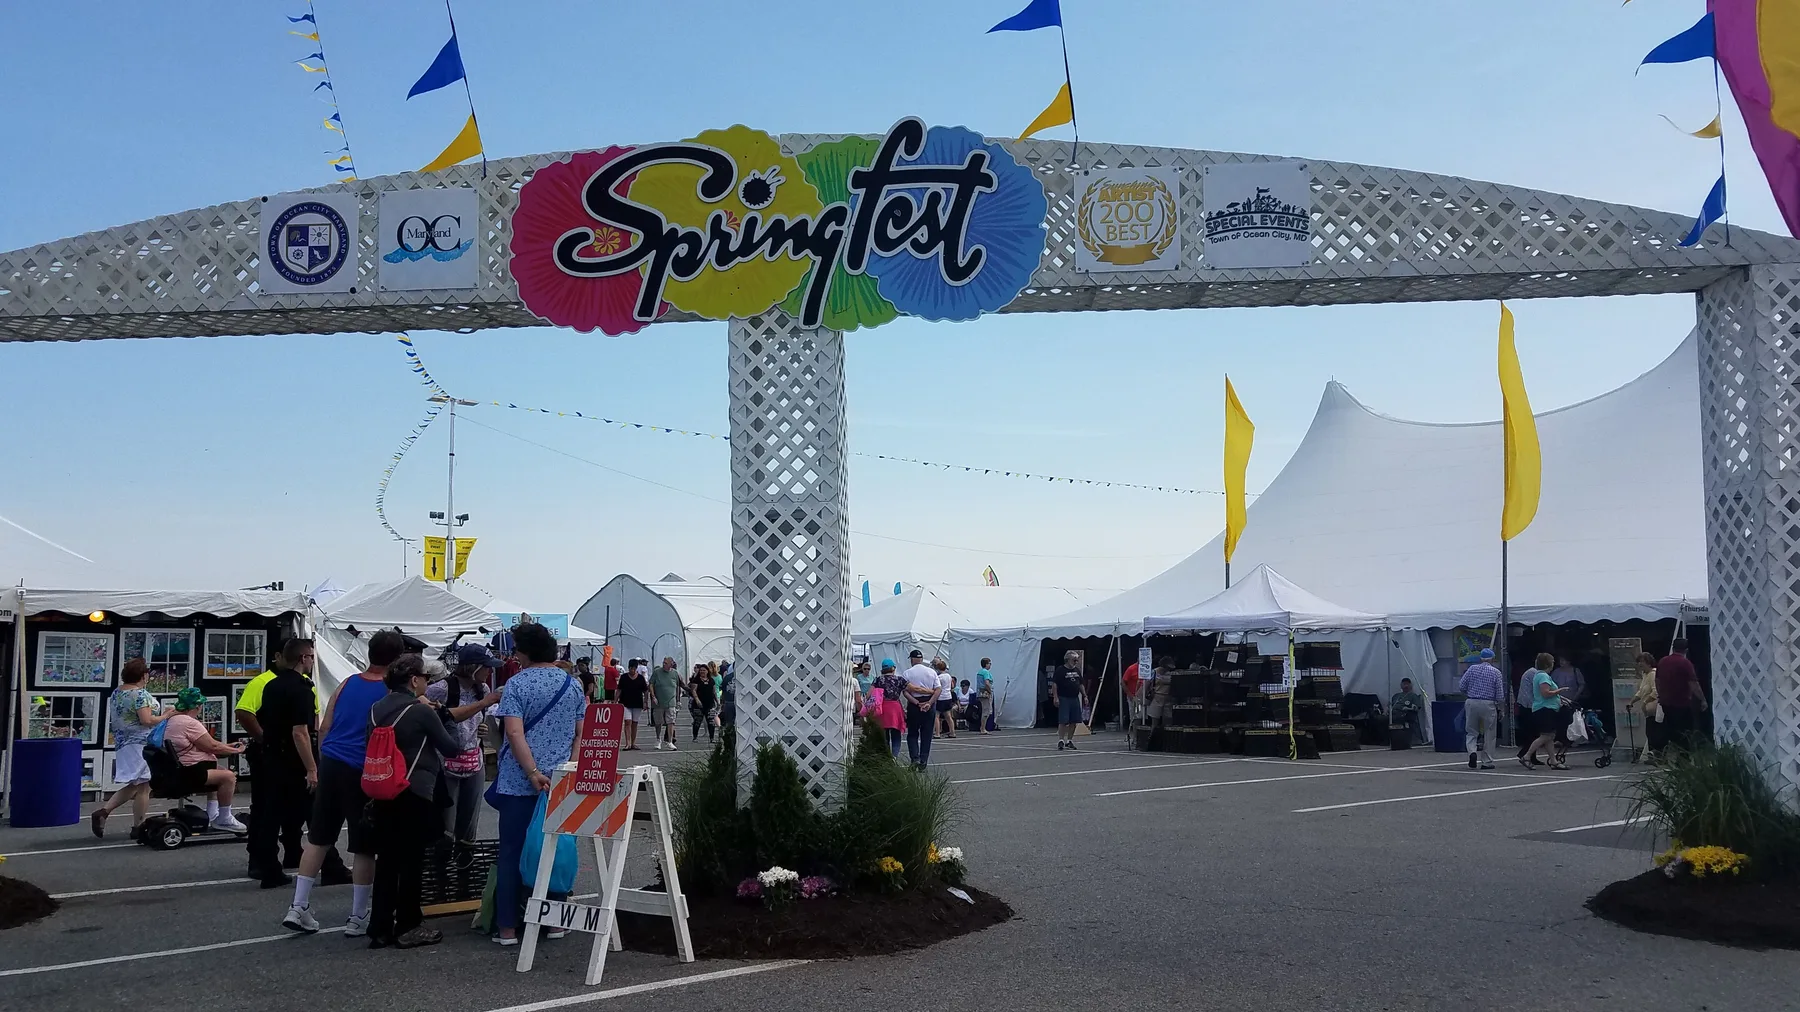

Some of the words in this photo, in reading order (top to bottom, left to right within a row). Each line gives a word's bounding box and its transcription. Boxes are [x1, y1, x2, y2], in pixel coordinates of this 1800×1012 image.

[1097, 187, 1156, 202] ARTIST
[1100, 201, 1154, 223] 200
[284, 205, 308, 220] OCEAN
[312, 205, 329, 214] CITY
[331, 213, 347, 254] MARYLAND
[555, 117, 997, 328] Springfest
[1205, 215, 1258, 234] SPECIAL
[1260, 214, 1310, 231] EVENTS
[397, 214, 461, 252] OC
[407, 227, 451, 240] Maryland
[1106, 223, 1152, 241] BEST
[1209, 235, 1230, 244] Town
[1231, 232, 1241, 240] of
[1242, 230, 1270, 238] Ocean
[1271, 230, 1292, 241] City,
[1293, 232, 1308, 242] MD
[281, 267, 316, 283] FOUNDED
[595, 707, 611, 724] NO
[592, 728, 609, 737] BIKES
[580, 738, 619, 748] SKATEBOARDS
[584, 749, 594, 758] OR
[595, 749, 612, 759] PETS
[591, 759, 602, 769] ON
[583, 769, 607, 780] EVENT
[575, 781, 611, 793] GROUNDS
